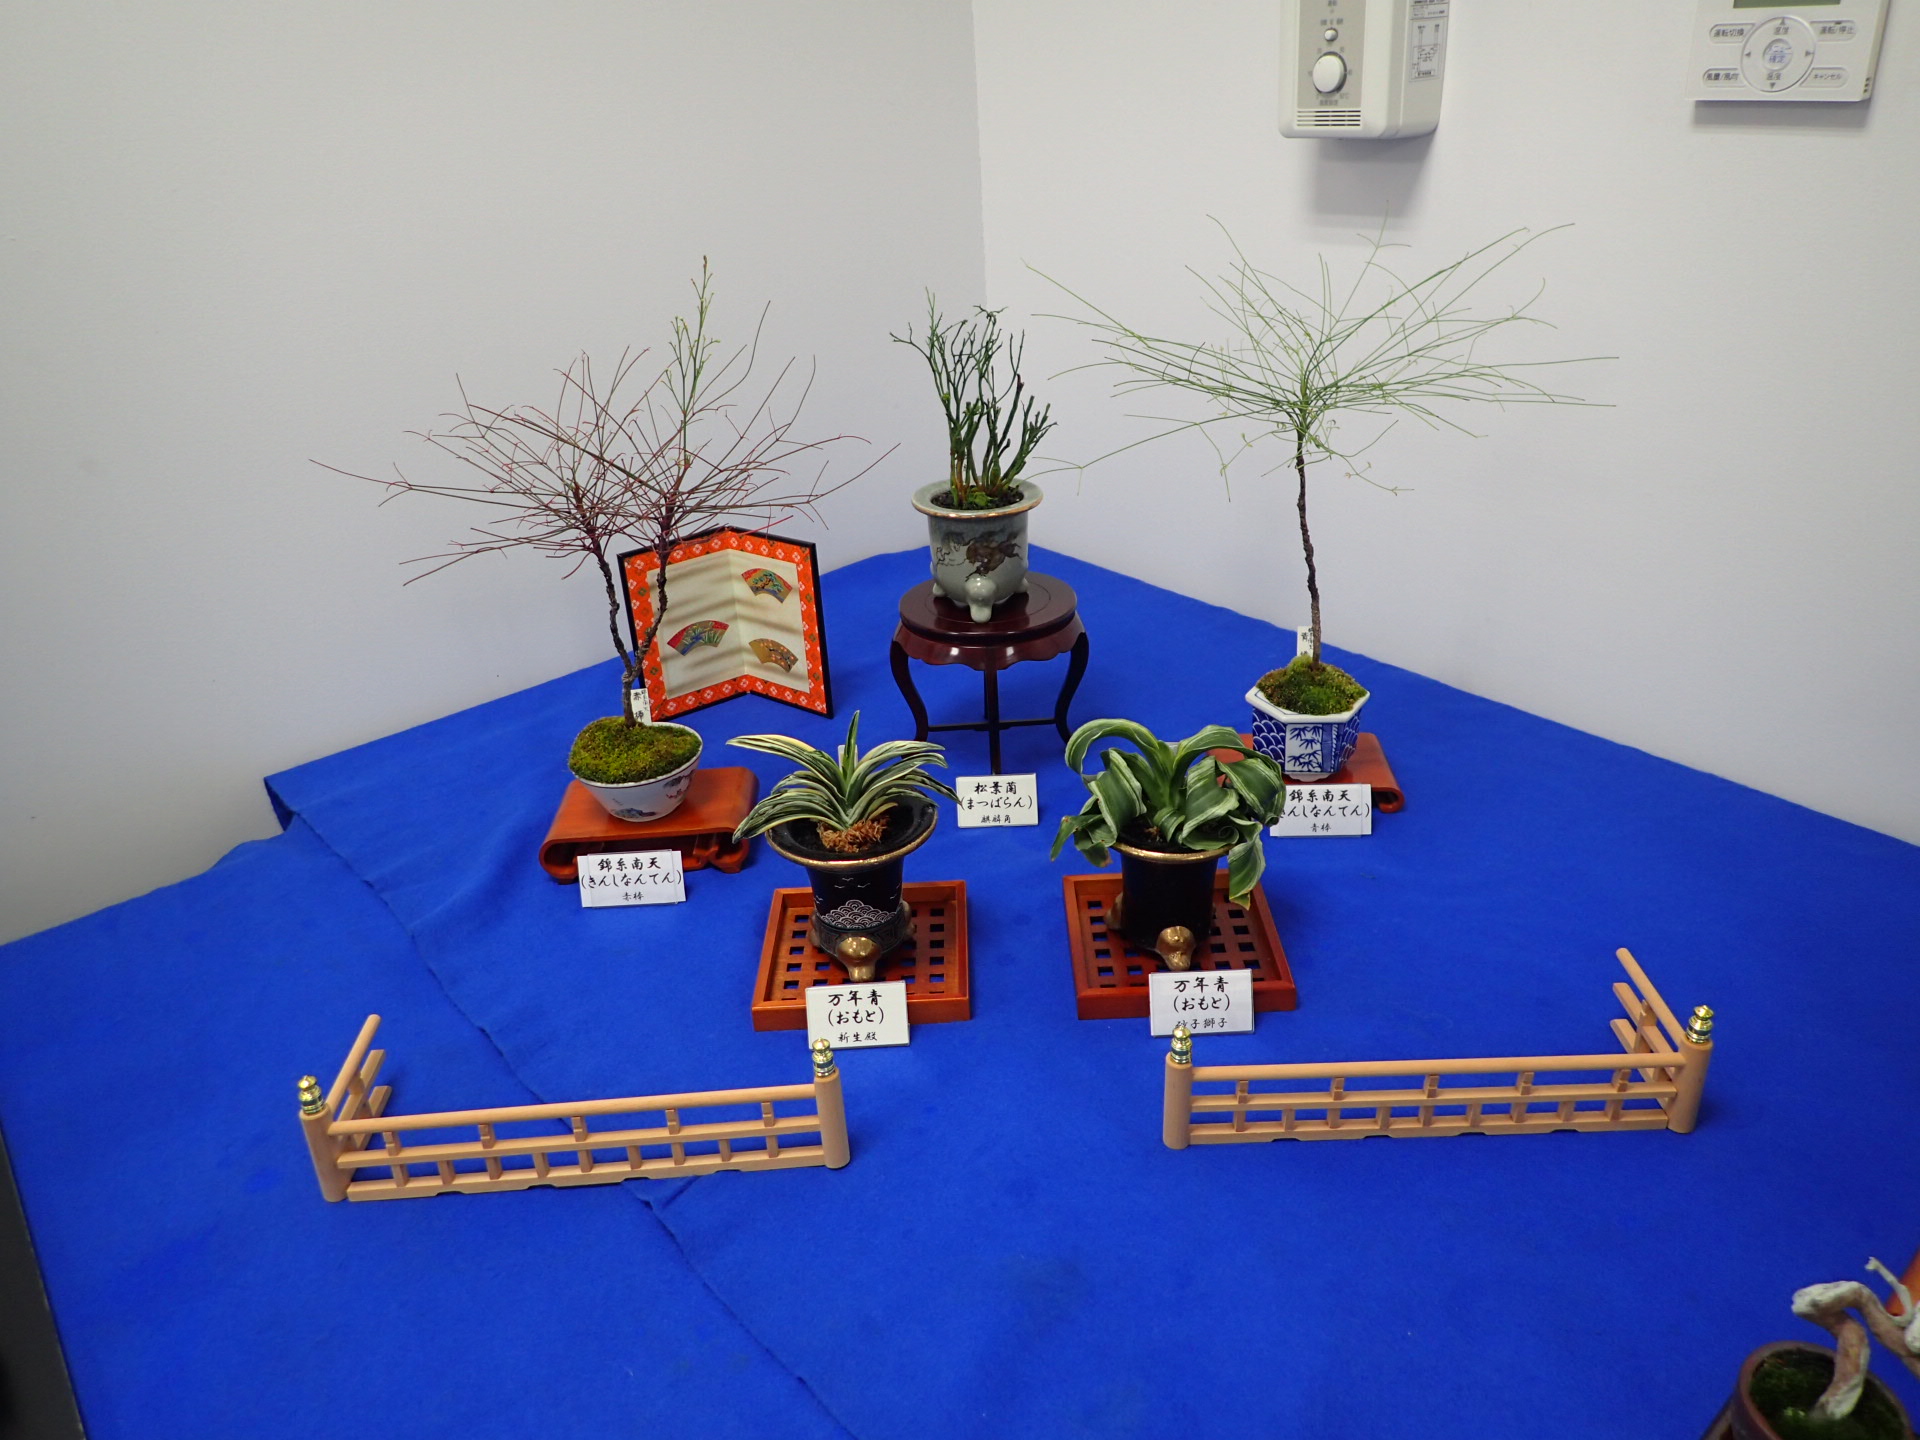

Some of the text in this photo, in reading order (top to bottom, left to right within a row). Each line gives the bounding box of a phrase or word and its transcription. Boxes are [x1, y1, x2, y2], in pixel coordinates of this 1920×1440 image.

[974, 781, 1017, 795] 松葉蘭
[960, 795, 1033, 810] (まつばらん)
[580, 869, 682, 889] (きんしなんてん)
[1174, 976, 1229, 993] 万年青
[828, 989, 882, 1006] 万年青
[1173, 994, 1230, 1013] (おもと)
[828, 1007, 884, 1026] (おもと)
